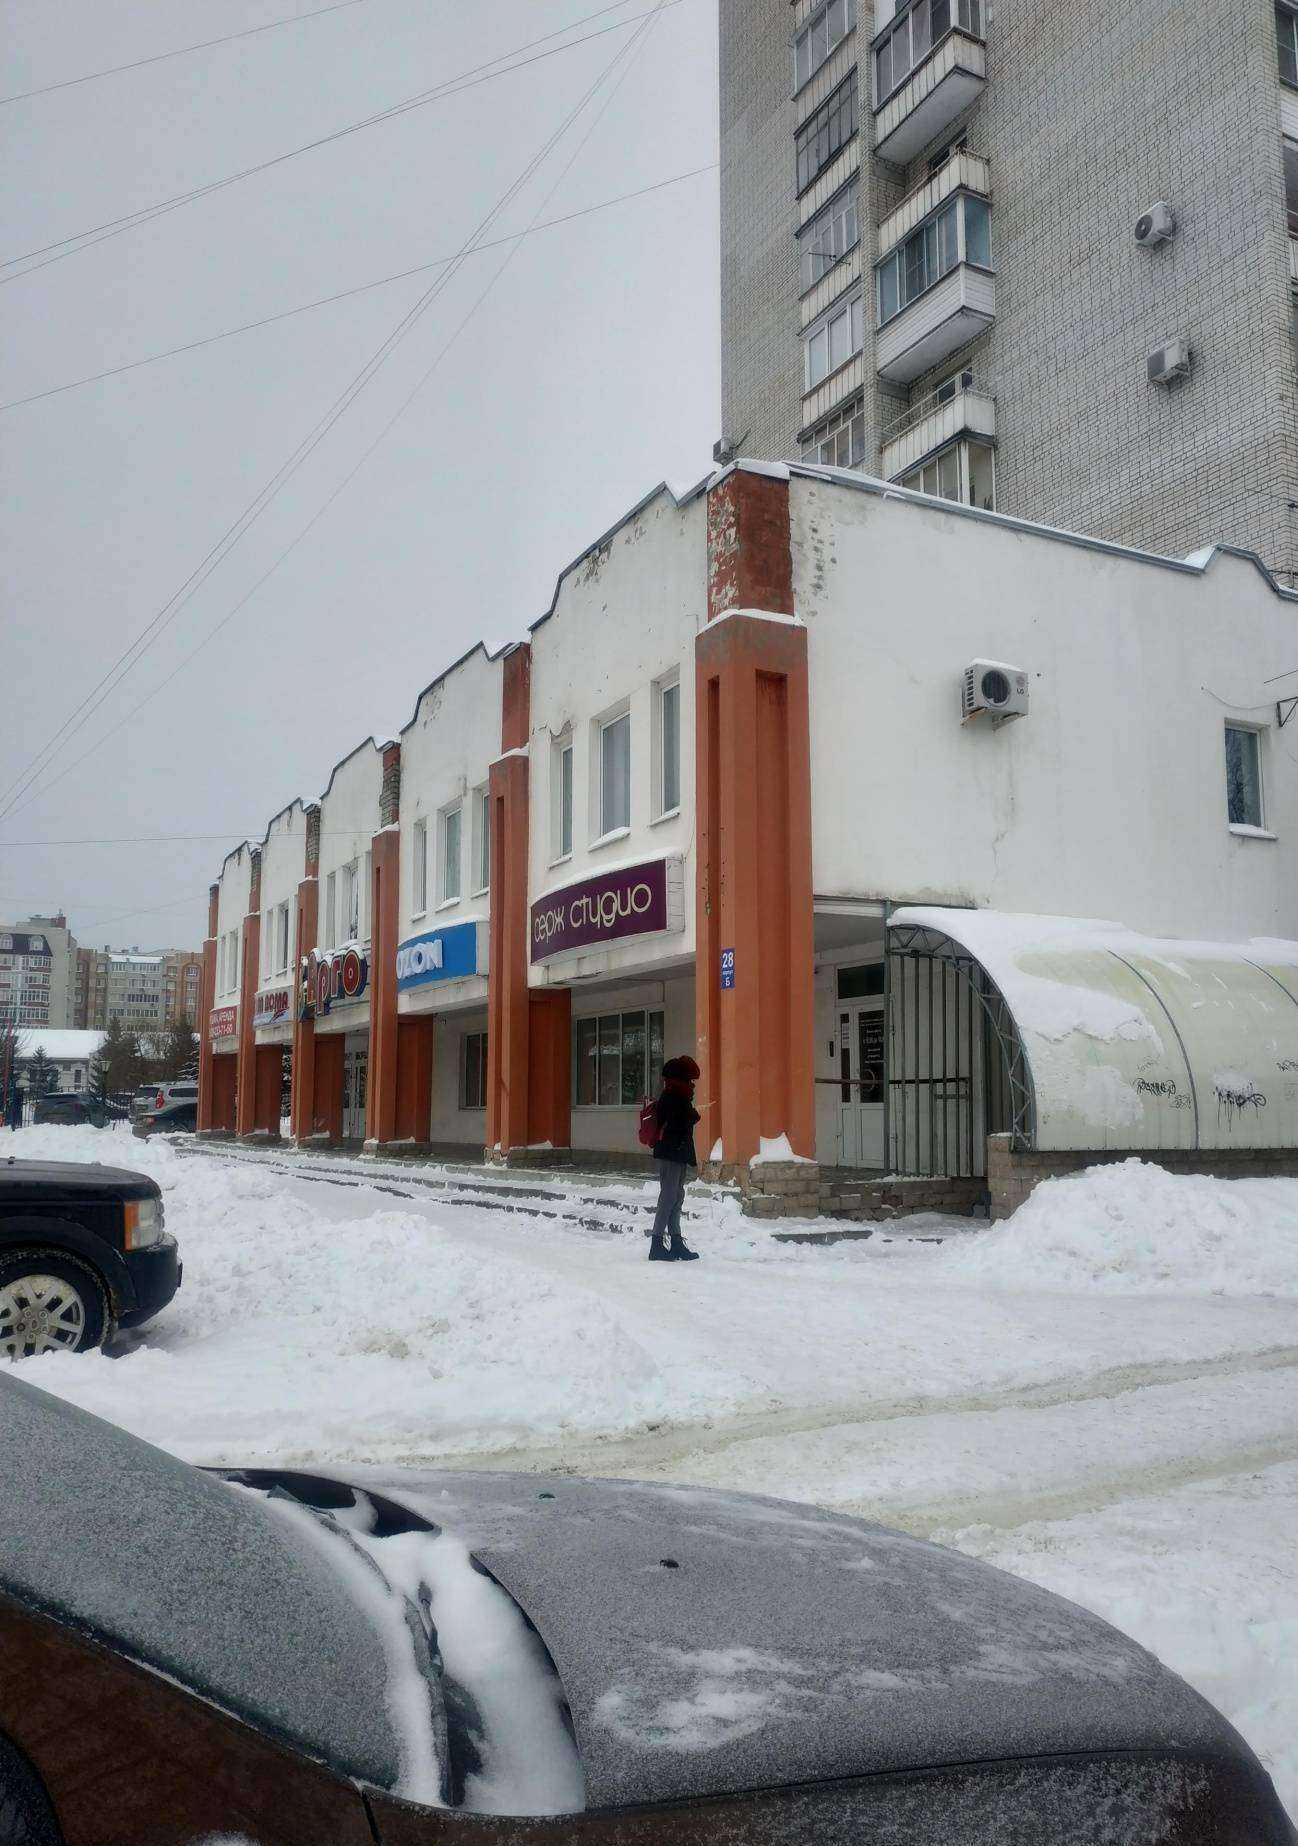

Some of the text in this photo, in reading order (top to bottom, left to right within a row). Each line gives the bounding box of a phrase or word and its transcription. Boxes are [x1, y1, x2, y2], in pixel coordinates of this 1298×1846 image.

[534, 883, 652, 943] серж студио
[722, 951, 734, 968] 28
